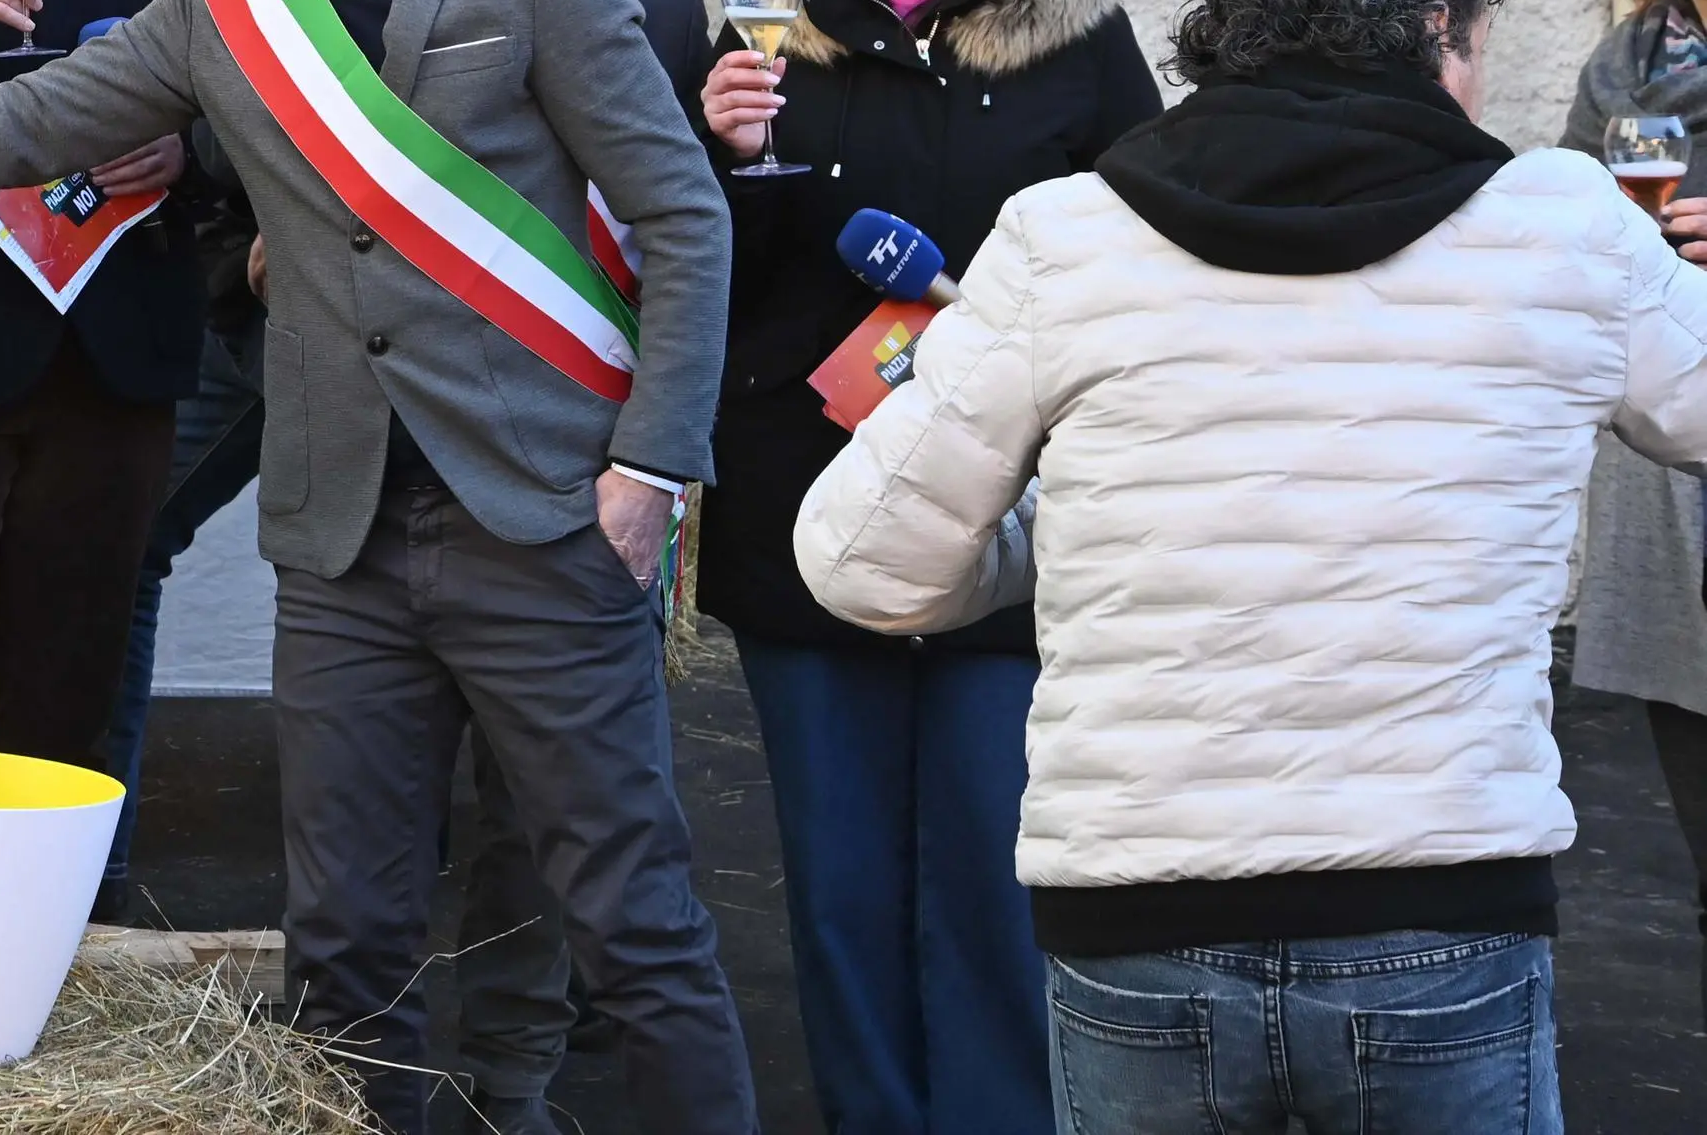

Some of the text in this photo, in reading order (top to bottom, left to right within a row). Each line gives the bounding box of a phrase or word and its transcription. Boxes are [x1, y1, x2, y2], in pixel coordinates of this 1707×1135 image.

[44, 182, 70, 211] PIAZZA
[72, 185, 97, 216] NOI
[886, 239, 919, 284] TELETUTTO
[884, 336, 901, 352] IN
[880, 352, 912, 383] PIAZZA
